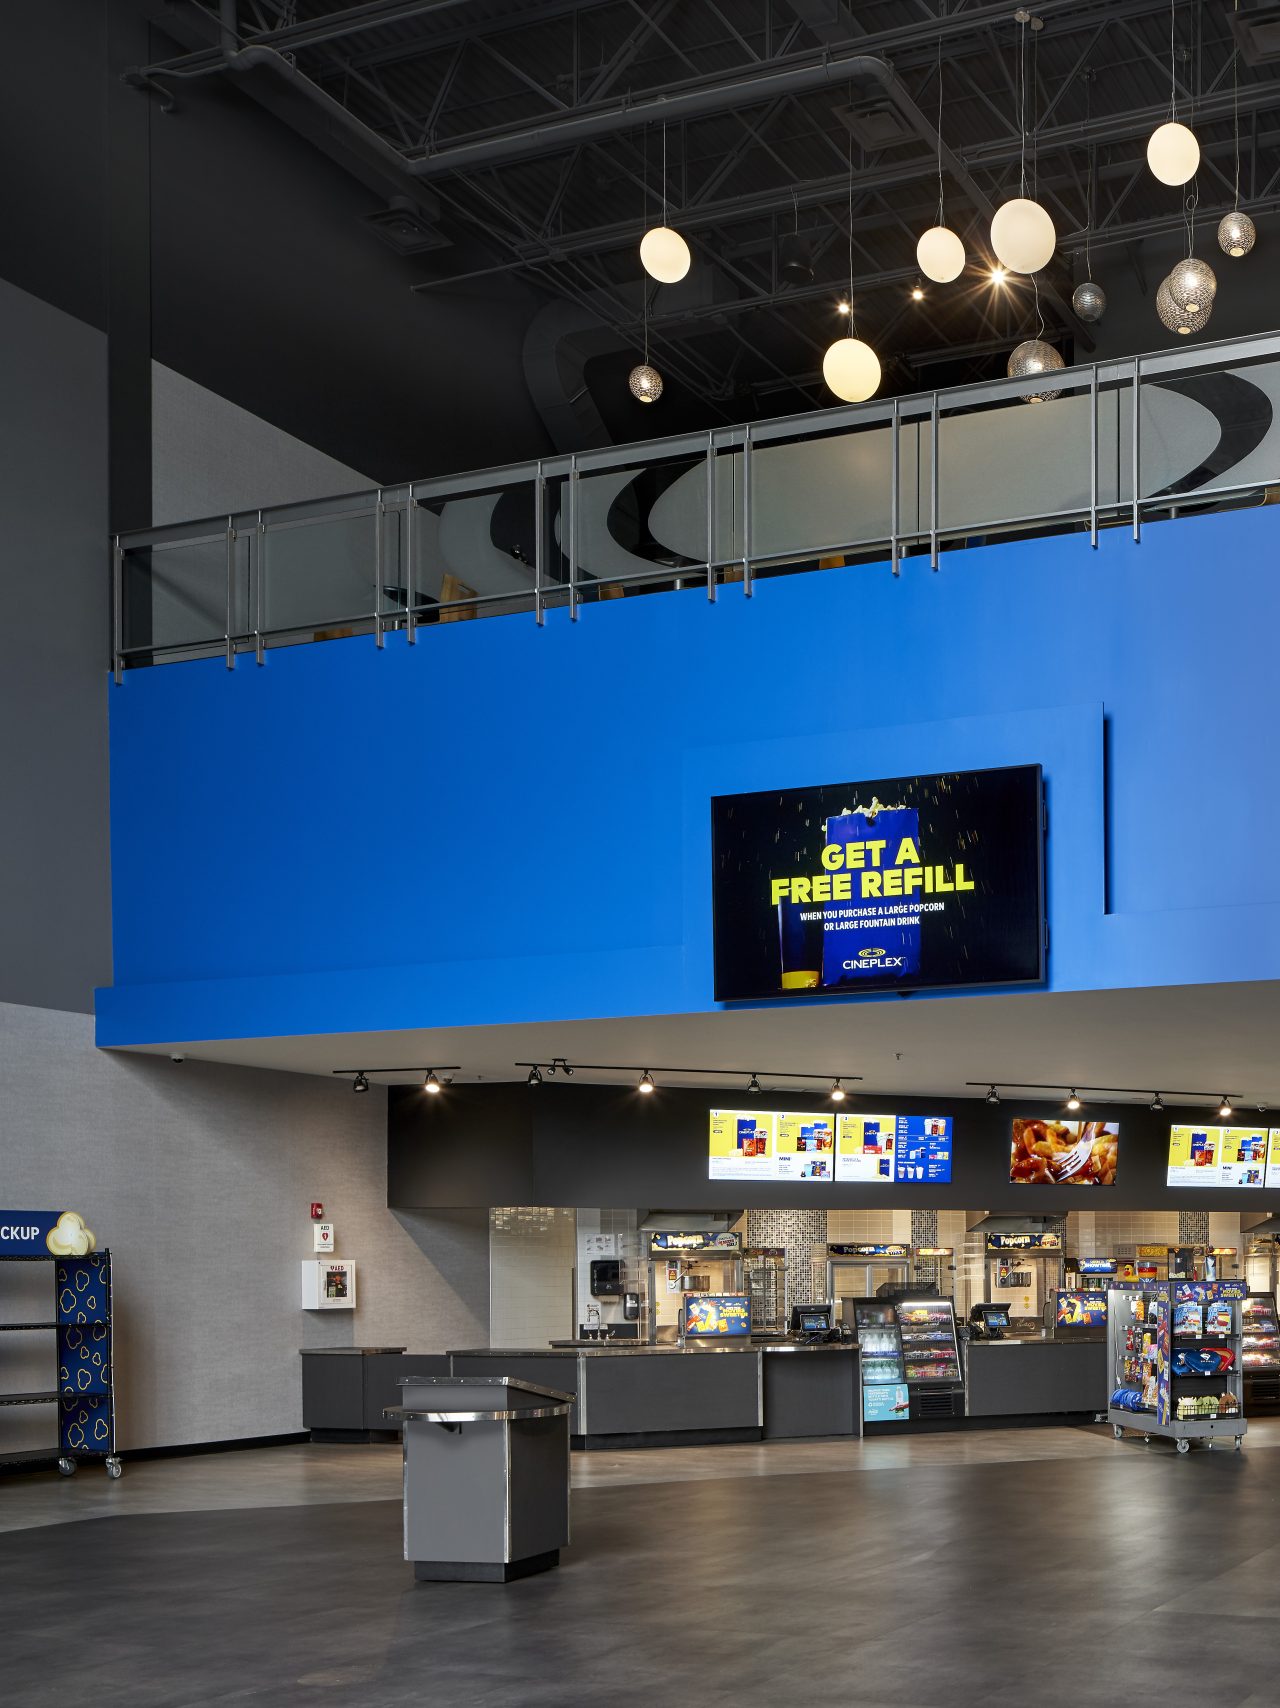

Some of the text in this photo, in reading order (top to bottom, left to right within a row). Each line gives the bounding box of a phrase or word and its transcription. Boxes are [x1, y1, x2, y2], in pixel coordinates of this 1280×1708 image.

[821, 837, 921, 871] GET A
[771, 863, 975, 905] FREE REFILL
[800, 902, 945, 922] WHEN YOU PURCHASE A LARGE POPCORN
[824, 916, 920, 931] OR LARGE FOUNTAIN DRINK
[842, 957, 902, 970] CINEPLEX
[667, 1234, 704, 1248] Popcorn
[1000, 1235, 1031, 1247] Popcorn
[843, 1246, 876, 1255] Popcorn
